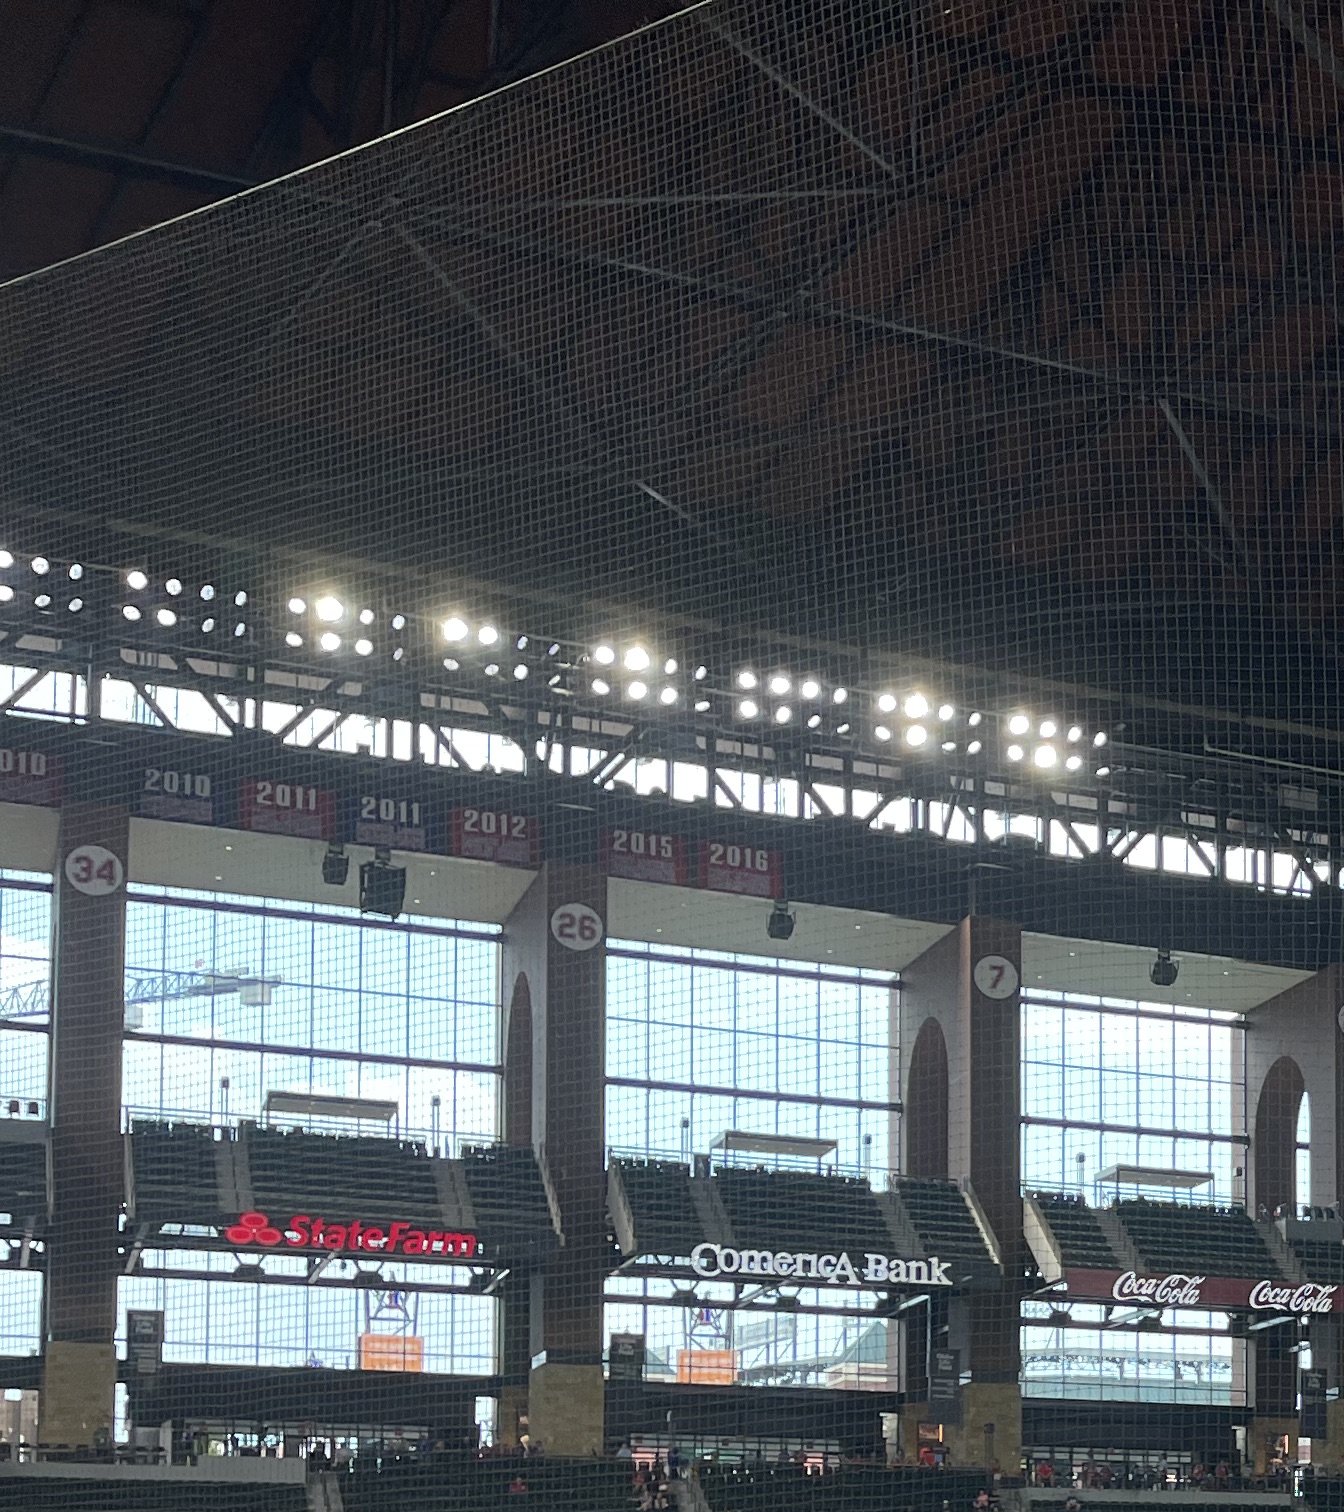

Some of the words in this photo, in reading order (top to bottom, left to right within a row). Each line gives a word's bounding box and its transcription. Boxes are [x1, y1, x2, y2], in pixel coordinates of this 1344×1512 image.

[144, 768, 211, 797] 2010
[256, 781, 317, 811] 2011
[361, 796, 420, 824] 2011
[464, 809, 527, 839] 2012
[613, 829, 673, 859] 2015
[709, 842, 768, 872] 2016
[71, 855, 116, 885] 34
[557, 912, 597, 941] 26
[987, 965, 1005, 989] 7
[865, 1253, 953, 1286] Bank
[1113, 1271, 1206, 1305] Coca-Cola
[1250, 1280, 1338, 1313] Coca-Cola
